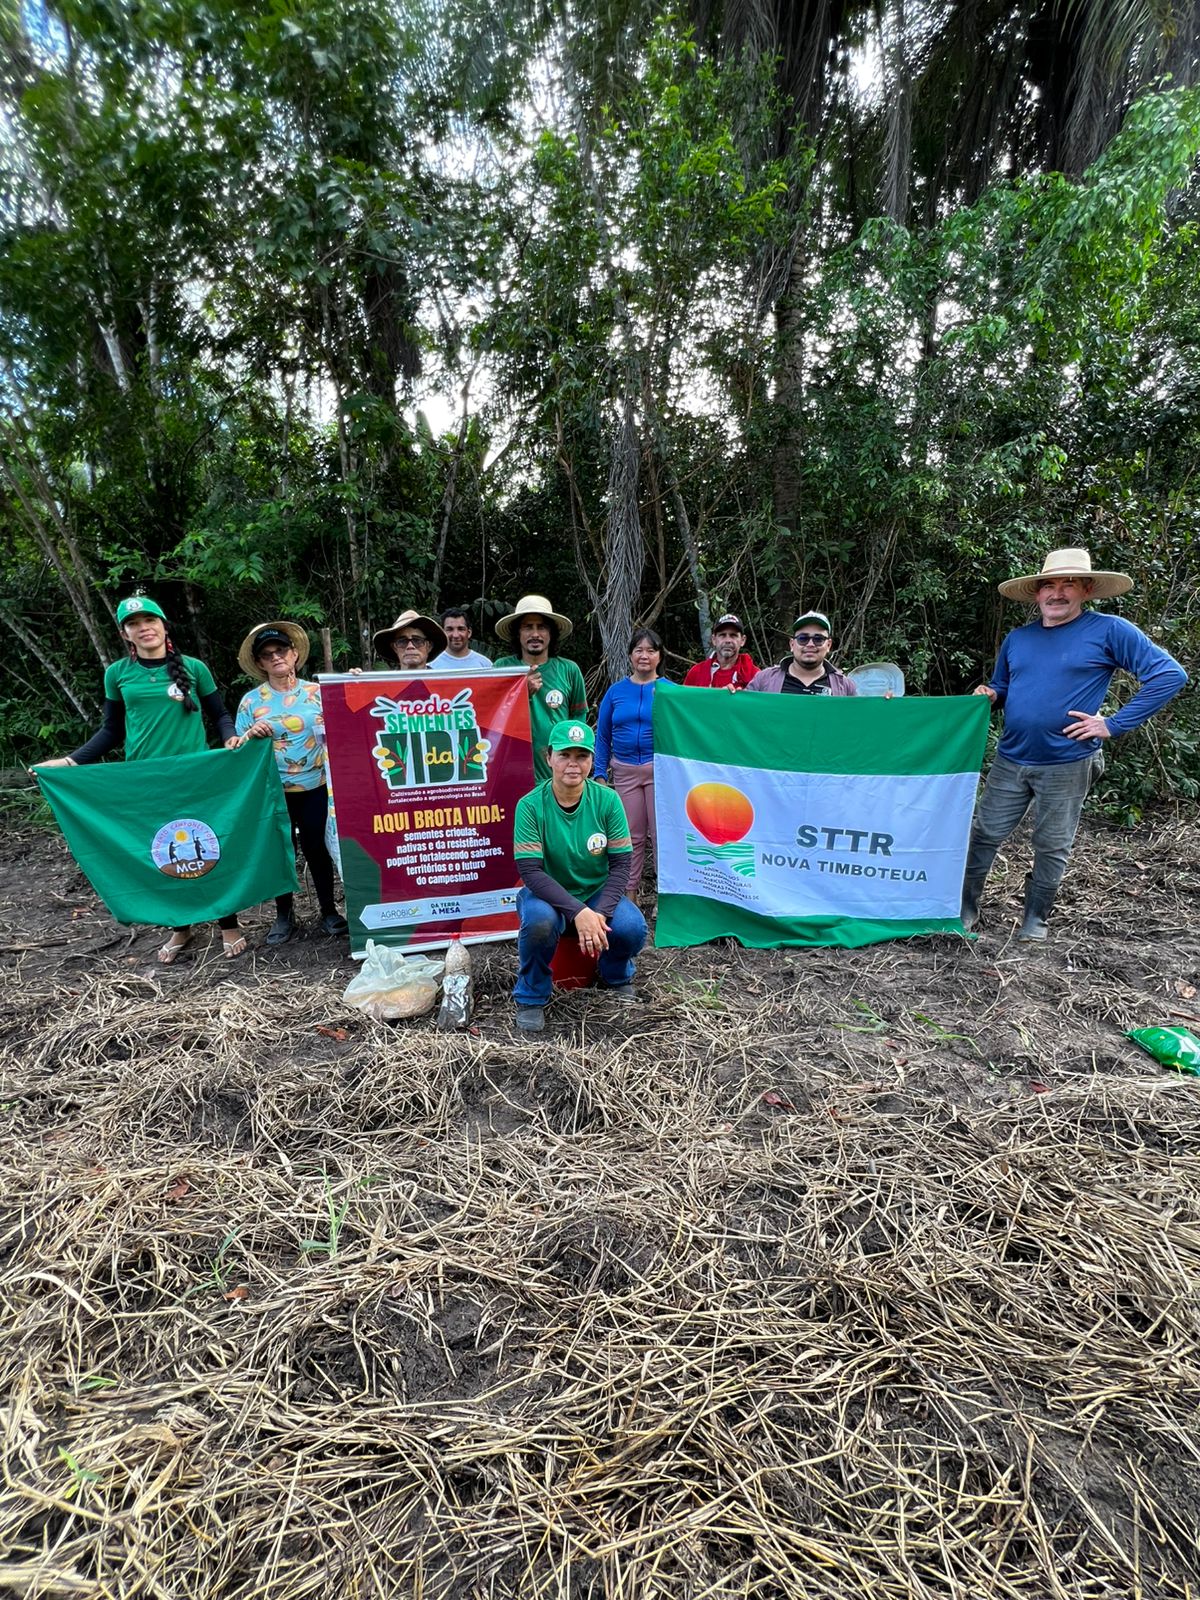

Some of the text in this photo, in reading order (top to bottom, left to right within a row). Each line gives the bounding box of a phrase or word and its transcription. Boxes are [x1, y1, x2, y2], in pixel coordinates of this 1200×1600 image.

[400, 698, 452, 715] rede
[387, 710, 474, 732] SEMENTES
[425, 746, 454, 764] da
[388, 796, 424, 804] fortalecendo
[428, 793, 463, 801] agroecologia
[390, 790, 422, 798] Cultivando
[374, 804, 505, 834] AQUI BROTA VIDA:
[404, 827, 480, 842] sementes crioulas,
[796, 824, 894, 856] STTR
[396, 836, 490, 854] nativas e da resistência
[386, 846, 504, 868] popular fortalecendo saberes,
[176, 860, 205, 874] MCP
[406, 860, 486, 876] territórios e o futuro
[762, 853, 928, 882] NOVA TIMBOTEUA
[416, 872, 478, 886] do campesinato
[381, 907, 414, 918] AGROBIO
[438, 906, 461, 914] MESA
